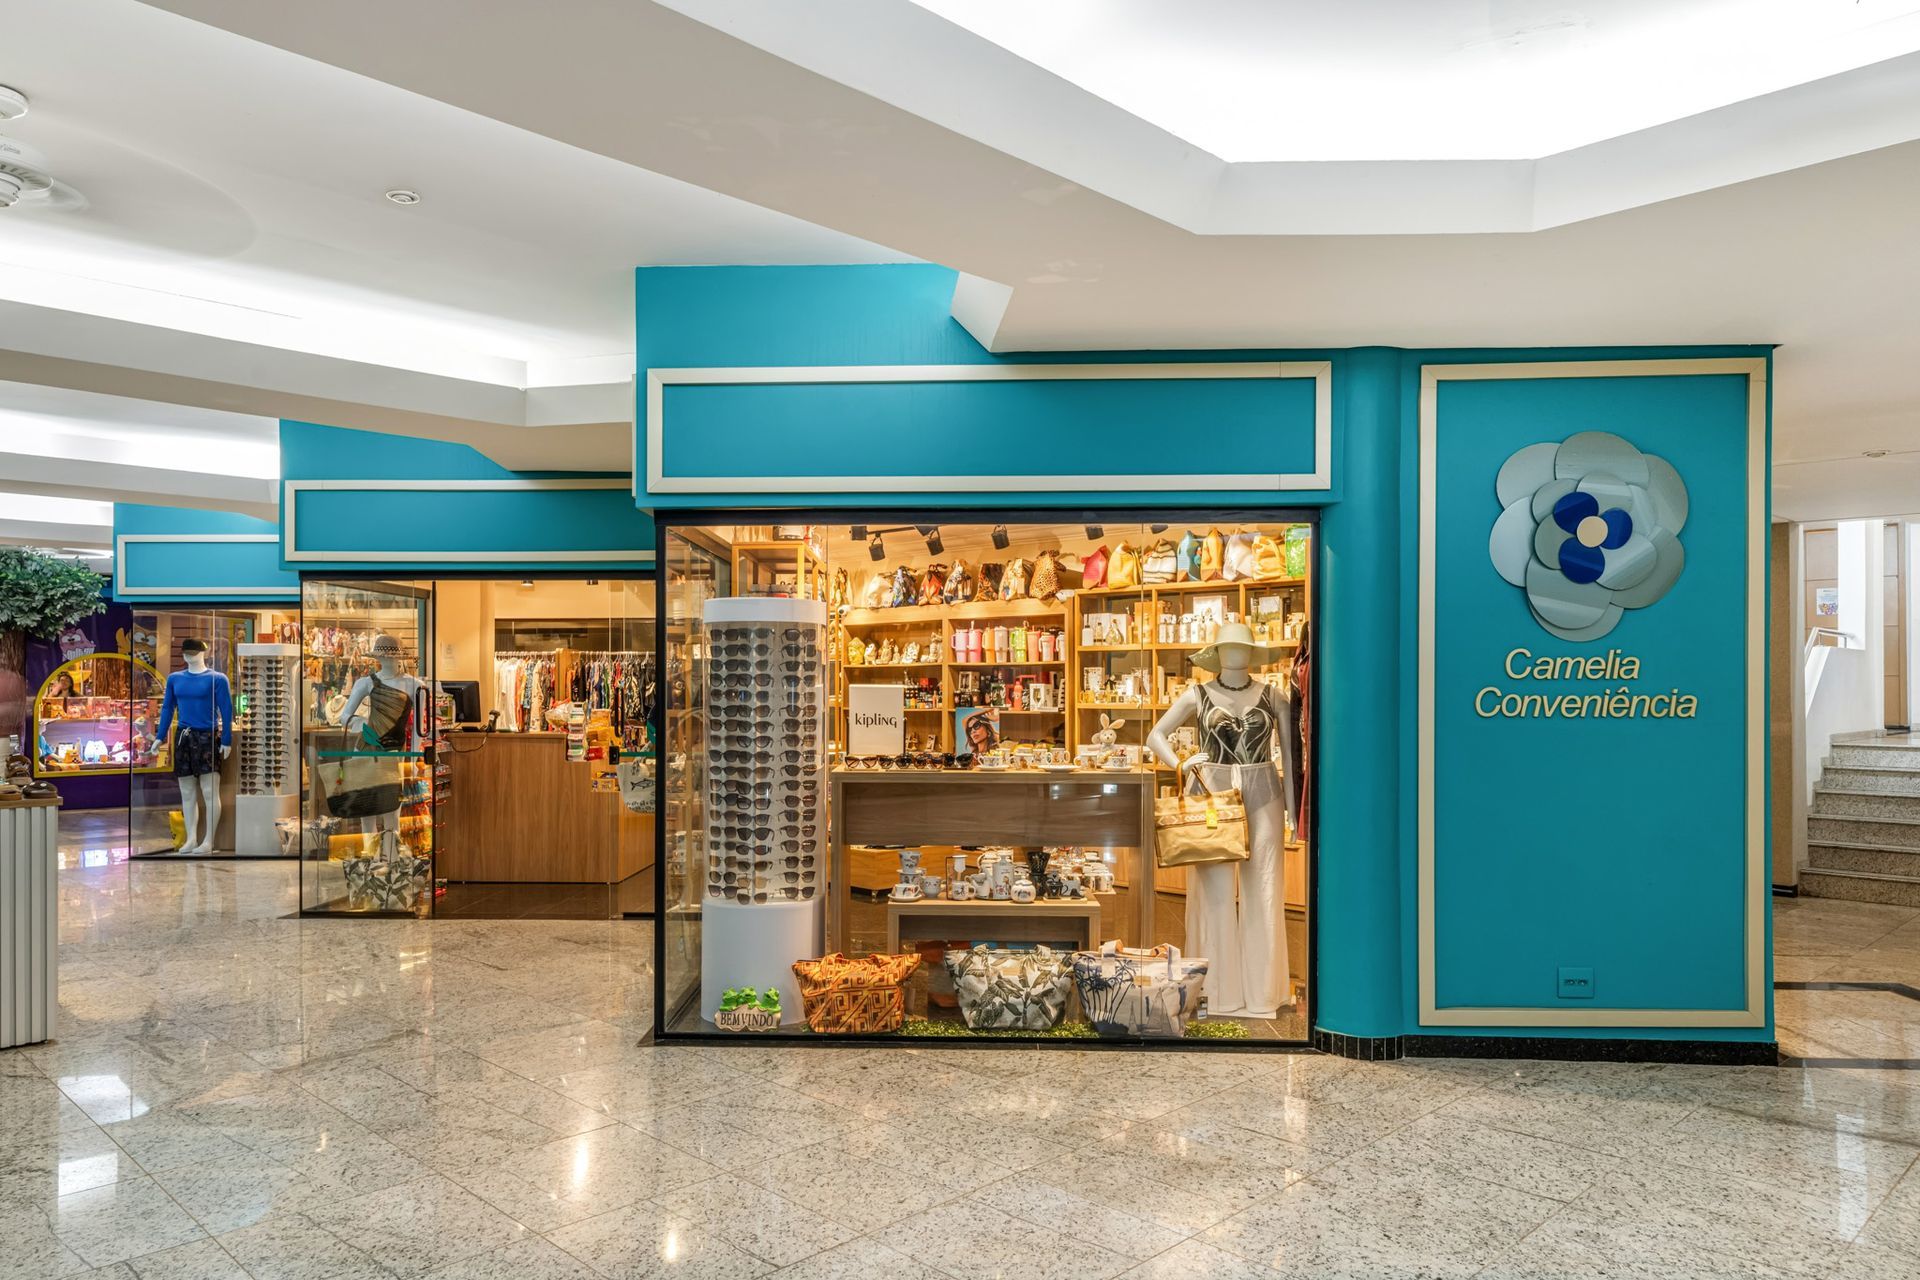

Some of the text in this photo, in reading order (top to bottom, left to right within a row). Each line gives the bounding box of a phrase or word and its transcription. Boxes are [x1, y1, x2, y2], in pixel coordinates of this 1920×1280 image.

[1504, 648, 1640, 680] Camelia
[1474, 686, 1698, 718] Conveniência
[855, 712, 898, 728] kipling
